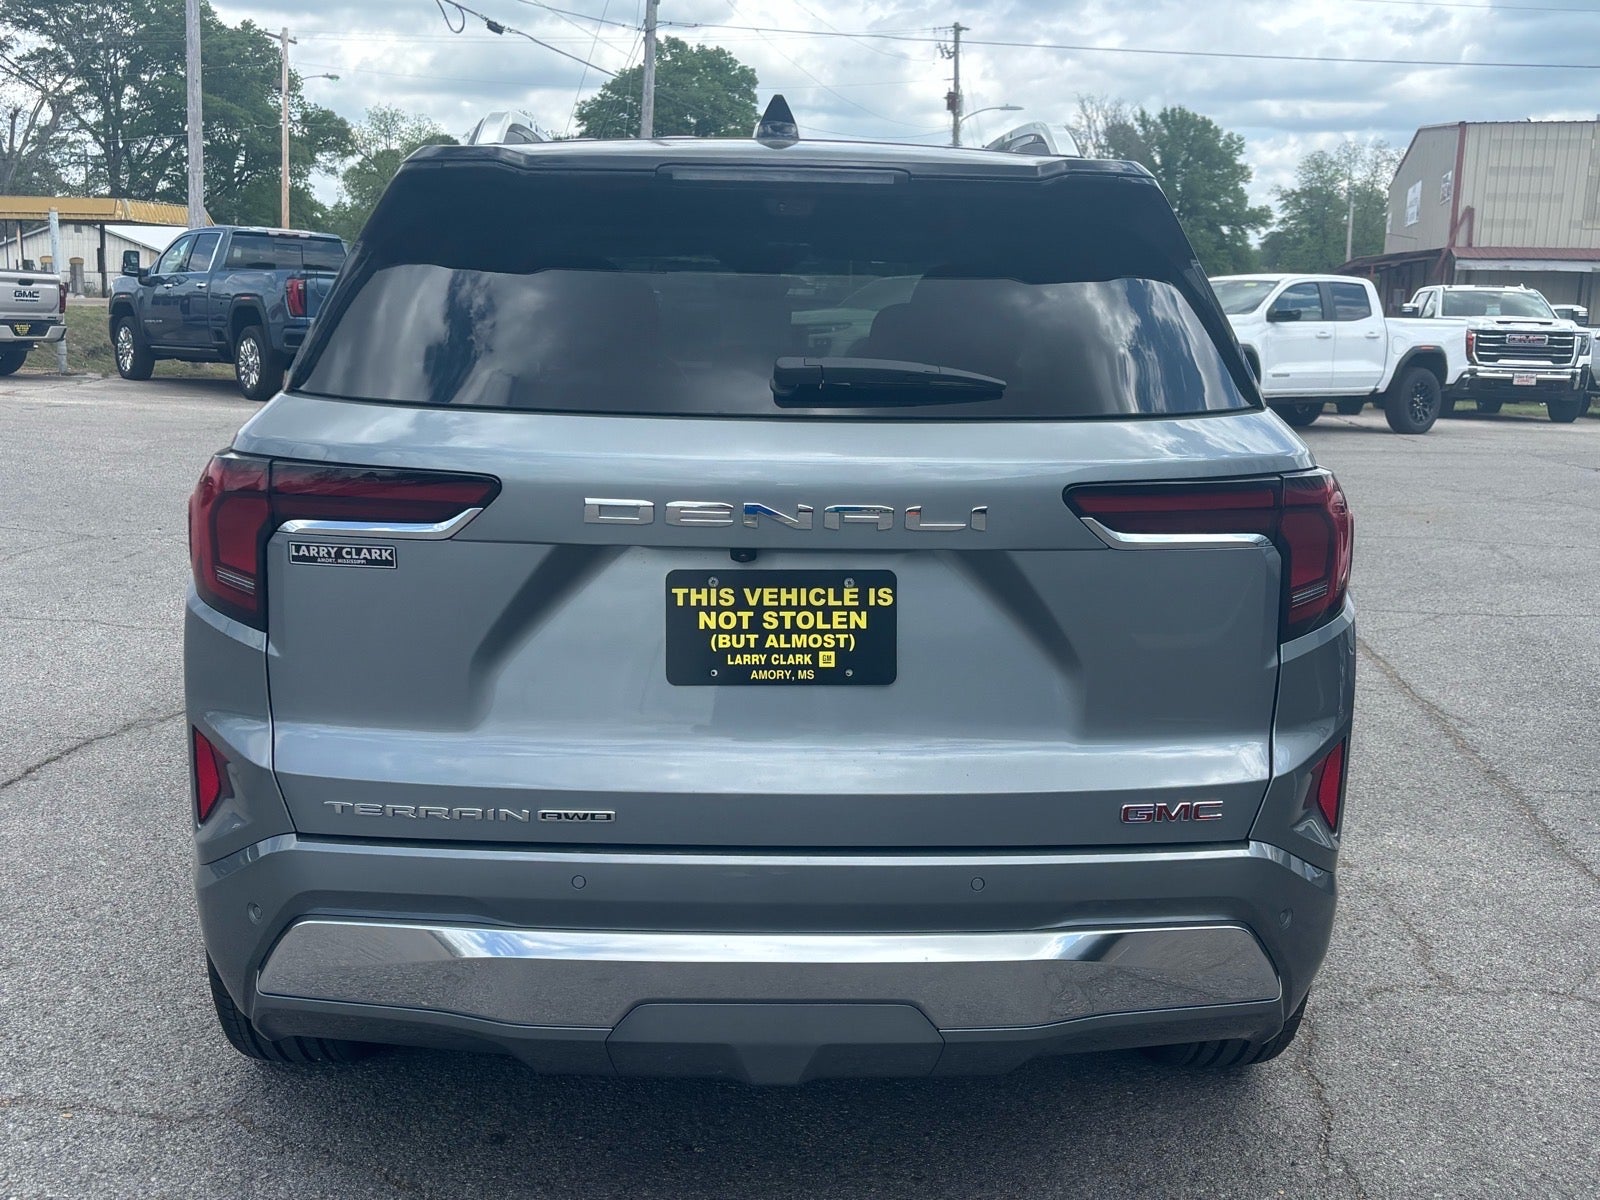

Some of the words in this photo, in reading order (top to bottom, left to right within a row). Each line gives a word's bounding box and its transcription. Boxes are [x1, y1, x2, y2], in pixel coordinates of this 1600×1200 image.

[14, 290, 40, 298] GMC
[583, 497, 988, 531] DENALI
[291, 545, 338, 558] LARRY
[342, 547, 393, 561] CLARK
[672, 588, 735, 606] THIS
[743, 588, 859, 606] VEHICLE
[868, 588, 894, 606] IS
[699, 611, 754, 630] NOT
[762, 611, 867, 630] STOLEN
[710, 633, 759, 652] (BUT
[765, 633, 856, 652] ALMOST)
[727, 653, 767, 665] LARRY
[771, 653, 812, 665] CLARK
[750, 669, 795, 681] AMORY,
[797, 669, 815, 680] MS
[323, 800, 530, 823] TERRAIN
[540, 810, 614, 822] AWD
[1121, 801, 1223, 824] GMC
